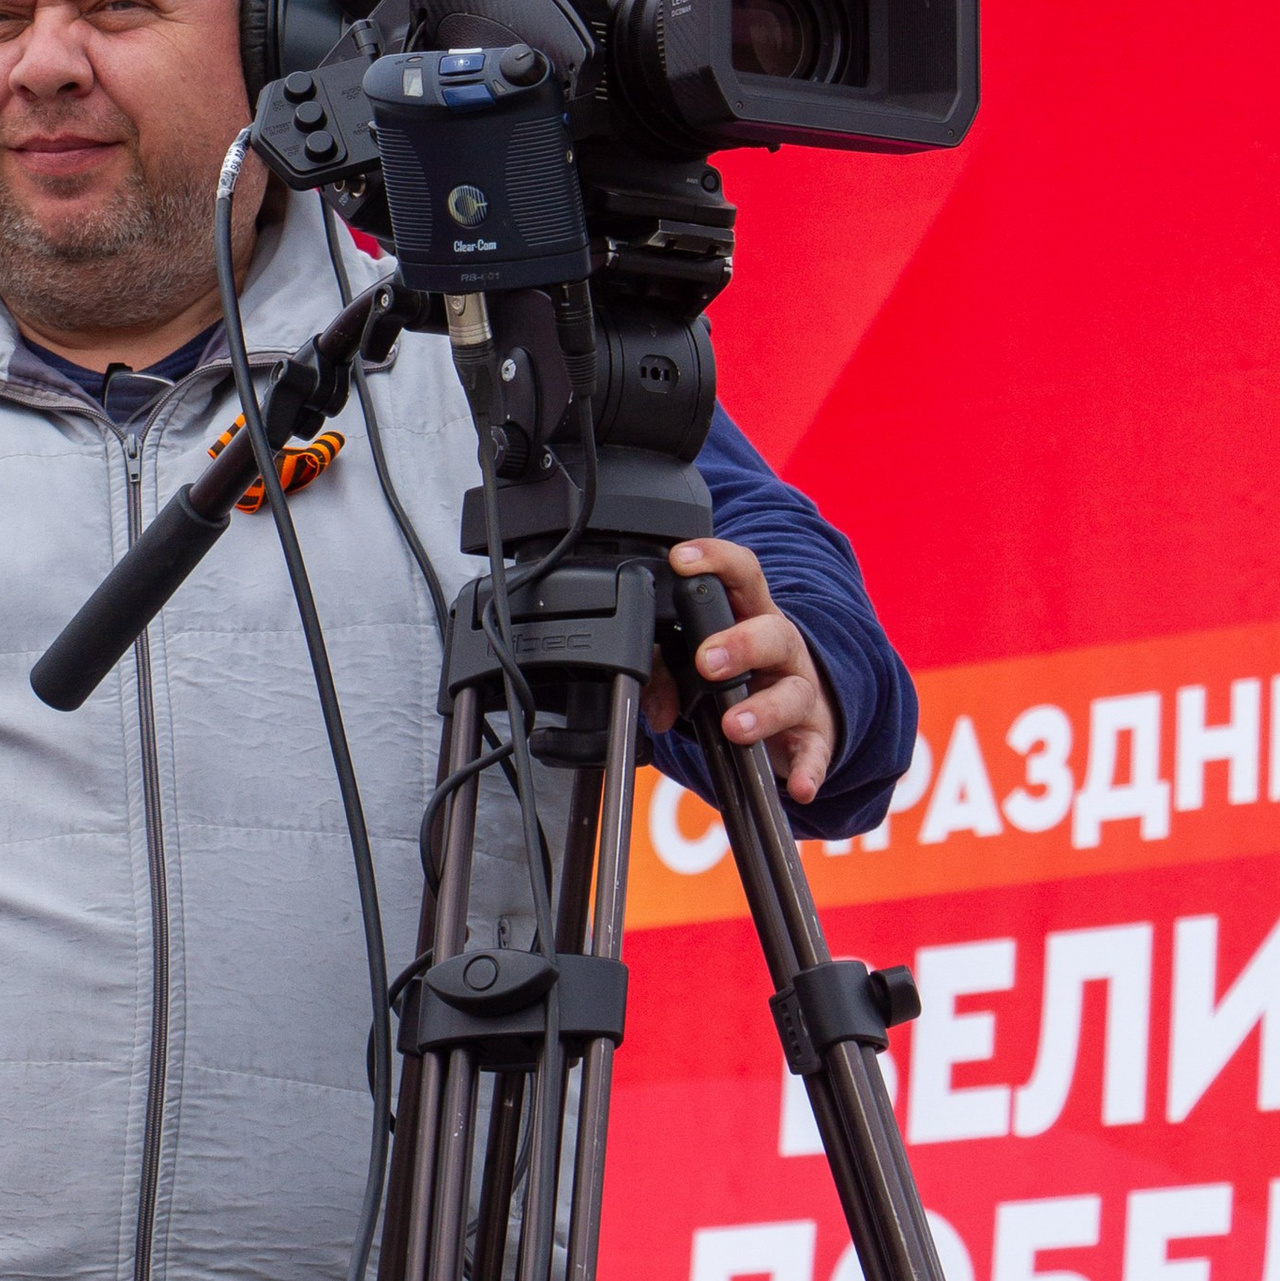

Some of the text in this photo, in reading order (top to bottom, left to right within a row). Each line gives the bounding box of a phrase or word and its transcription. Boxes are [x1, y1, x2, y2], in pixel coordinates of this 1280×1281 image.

[453, 239, 497, 253] Clear-Com
[487, 633, 593, 658] bec
[795, 677, 1280, 857] РАЗДН
